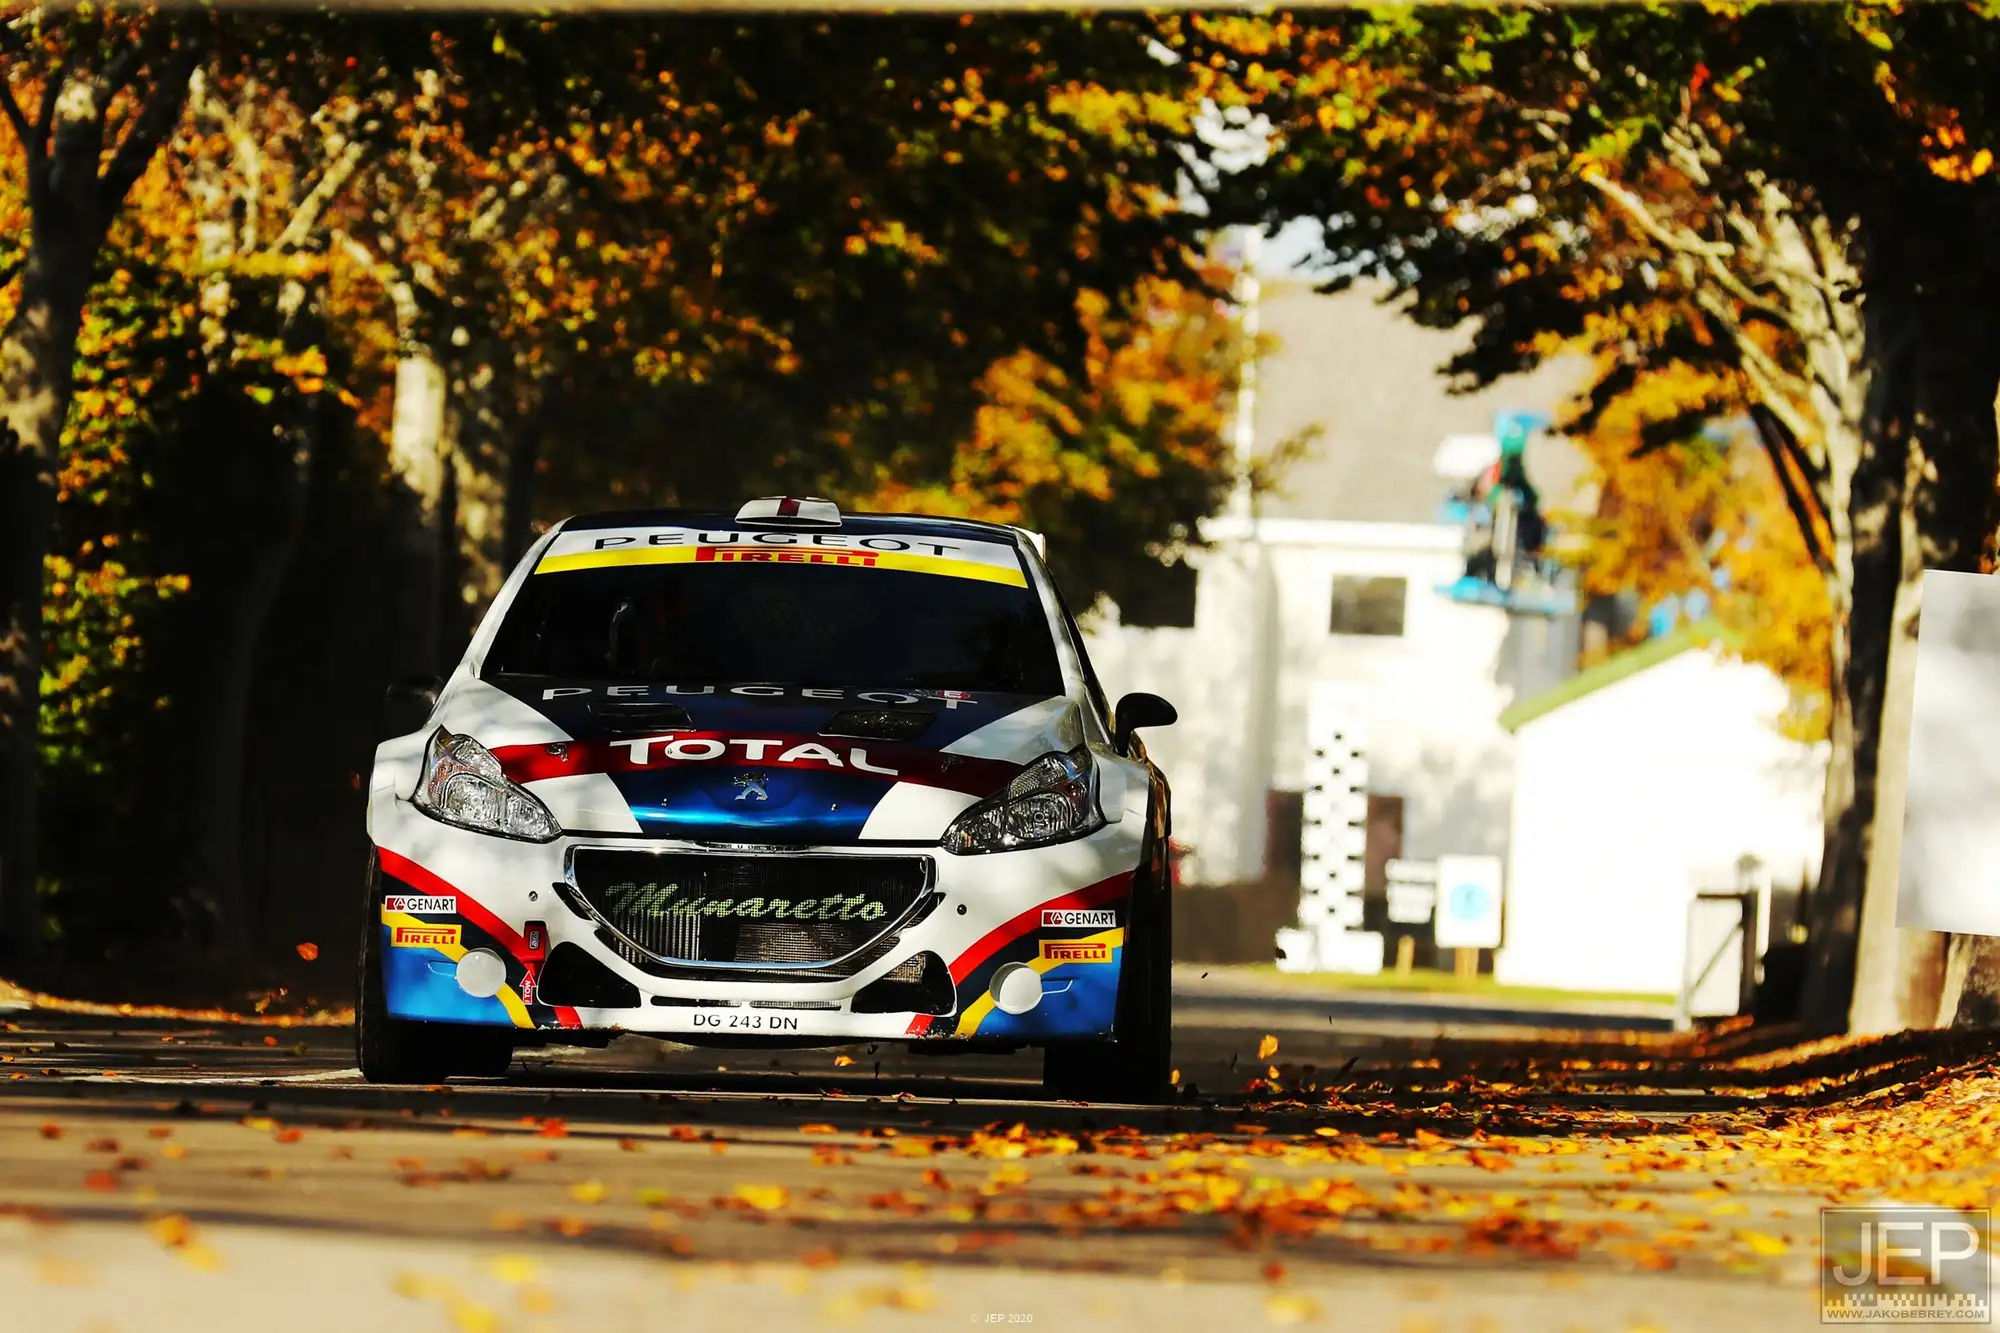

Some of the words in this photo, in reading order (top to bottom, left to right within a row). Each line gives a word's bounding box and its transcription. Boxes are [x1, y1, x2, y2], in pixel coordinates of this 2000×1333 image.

[595, 532, 960, 556] PEUGEOT
[695, 546, 880, 566] PIRELLI
[542, 685, 978, 709] PEUGEOT
[610, 735, 899, 776] TOTAL
[407, 898, 455, 911] GENART
[605, 882, 888, 921] Munaretto
[1064, 912, 1115, 925] GENART
[396, 927, 456, 945] PIRELLI
[1044, 943, 1107, 959] PIRELLI
[693, 1014, 721, 1027] DG
[729, 1015, 762, 1029] 243
[769, 1016, 798, 1030] DN
